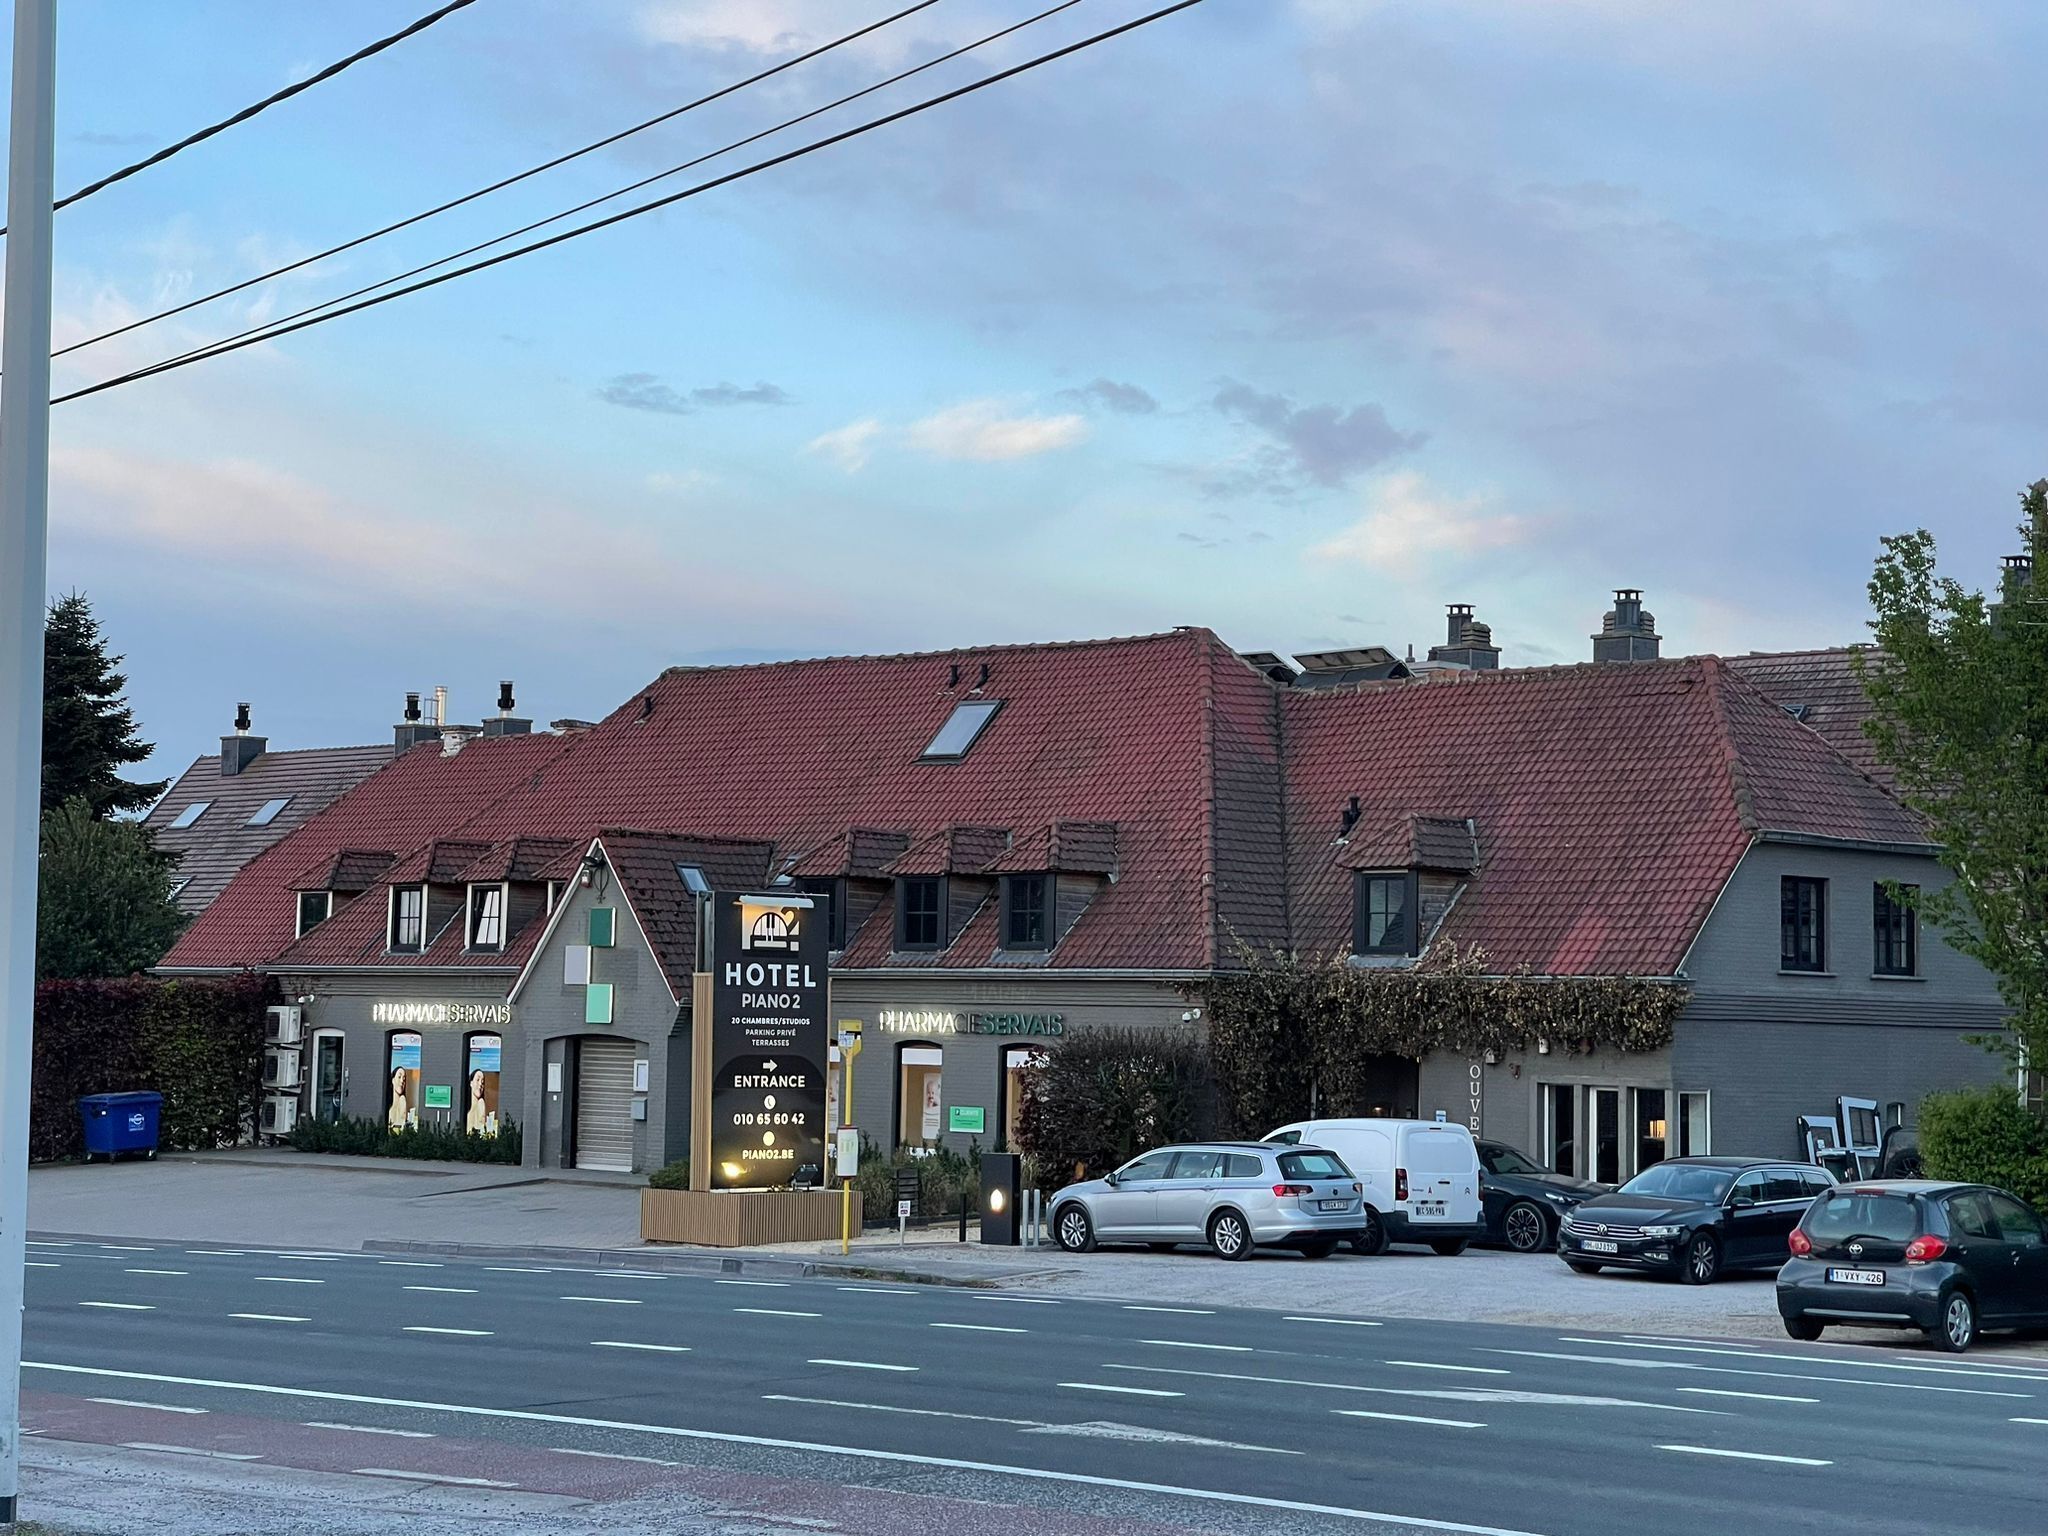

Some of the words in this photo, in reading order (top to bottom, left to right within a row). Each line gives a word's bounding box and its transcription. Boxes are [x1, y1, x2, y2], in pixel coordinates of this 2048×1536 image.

[725, 963, 816, 988] HOTEL
[731, 1016, 740, 1025] 20
[745, 1028, 775, 1036] PARKING
[776, 1028, 796, 1036] PRIVÉ
[751, 1039, 790, 1047] TERRASSES
[734, 1074, 806, 1088] ENTRANCE
[733, 1113, 754, 1126] 010
[756, 1113, 771, 1126] 65
[773, 1113, 788, 1126] 60
[791, 1112, 805, 1126] 42
[742, 1149, 794, 1160] PIANO2.BE
